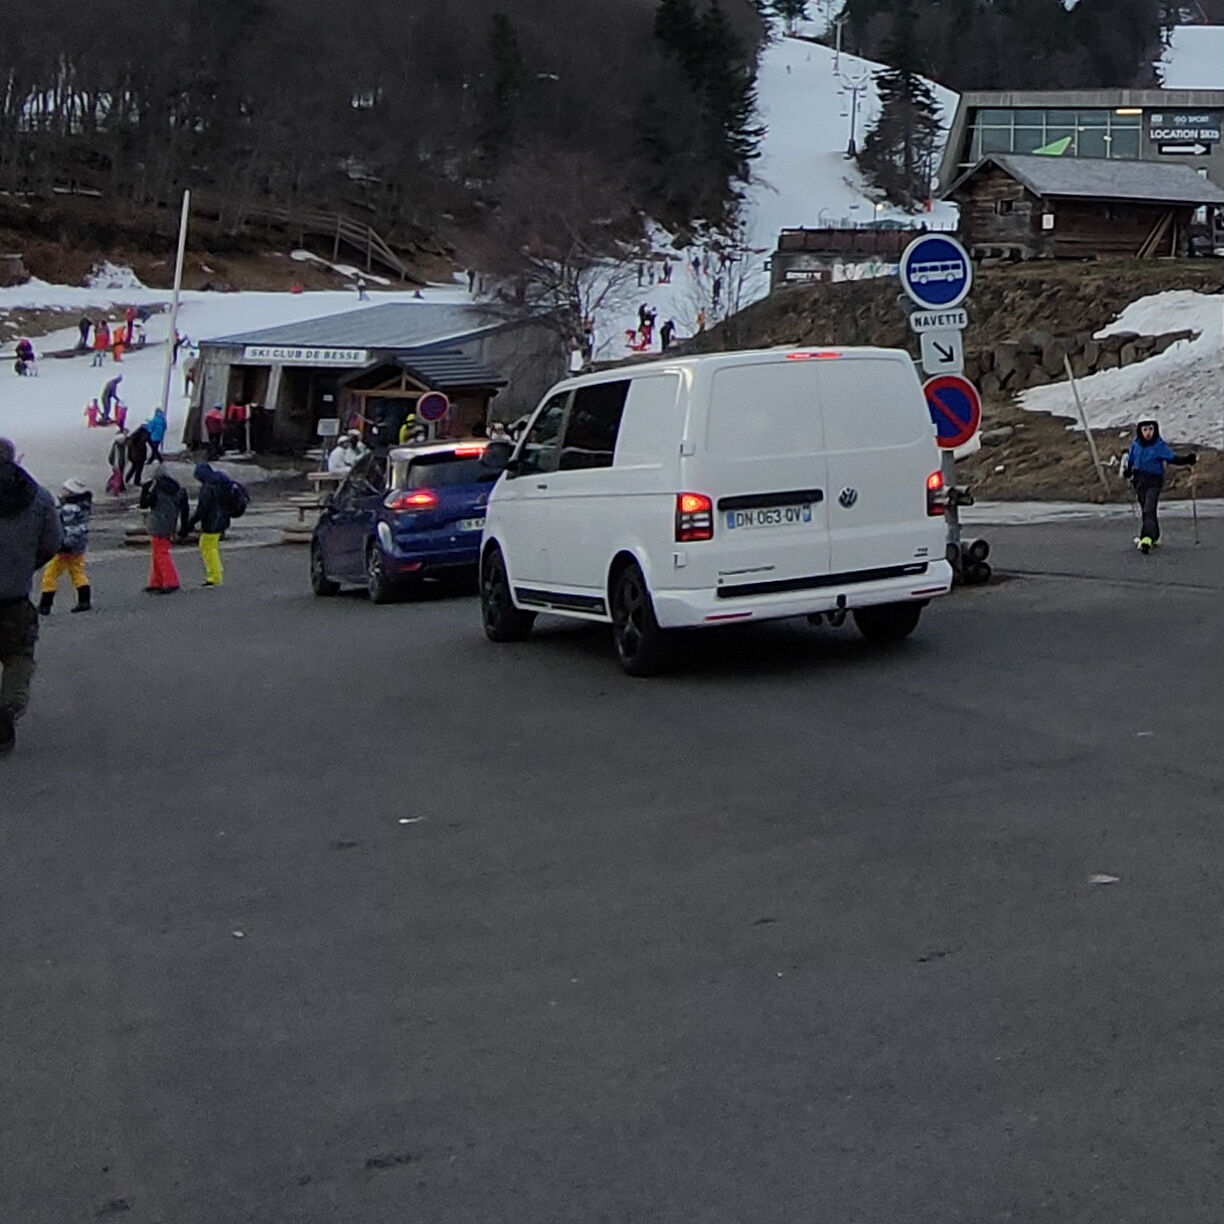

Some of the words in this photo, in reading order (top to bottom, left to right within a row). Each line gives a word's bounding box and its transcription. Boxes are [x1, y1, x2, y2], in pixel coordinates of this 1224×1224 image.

[1150, 129, 1198, 139] LOCATION
[914, 313, 965, 327] NAVETTE
[250, 348, 270, 357] SKI
[272, 349, 302, 359] CLUB
[305, 350, 320, 359] DE
[323, 351, 360, 360] BESSE
